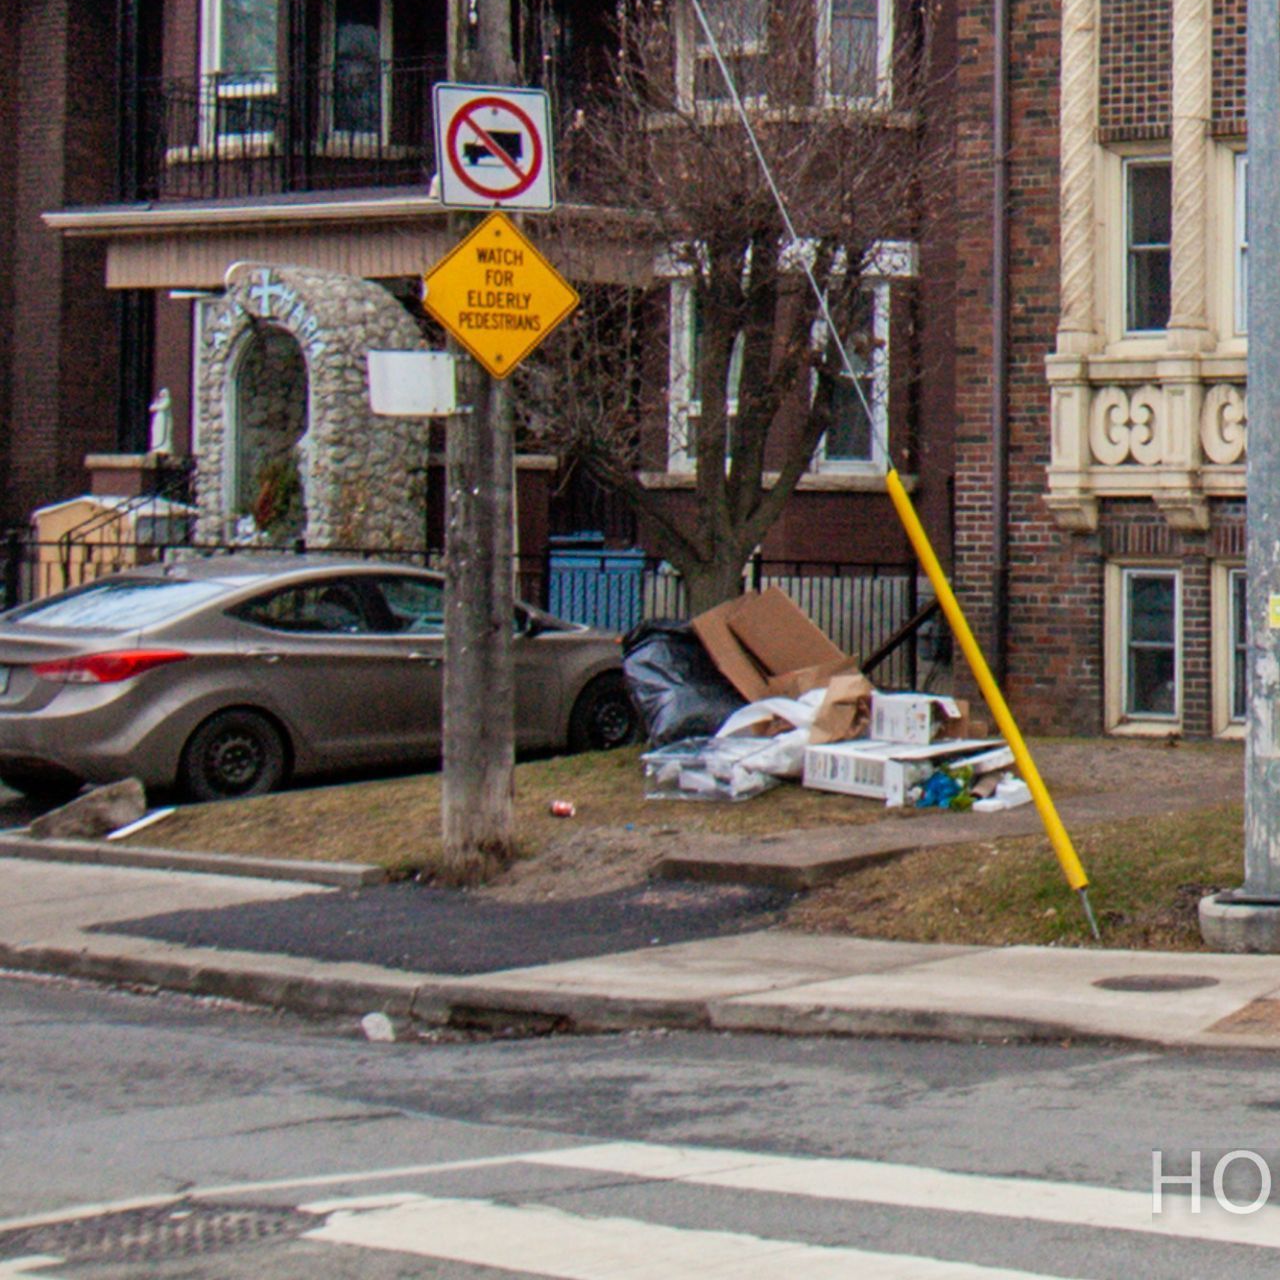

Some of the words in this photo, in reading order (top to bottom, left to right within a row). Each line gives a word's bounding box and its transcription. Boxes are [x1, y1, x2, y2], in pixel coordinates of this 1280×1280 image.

[476, 247, 524, 266] WATCH
[485, 269, 514, 287] FOR
[467, 290, 532, 310] ELDERLY
[459, 312, 541, 331] PEDESTRIANS
